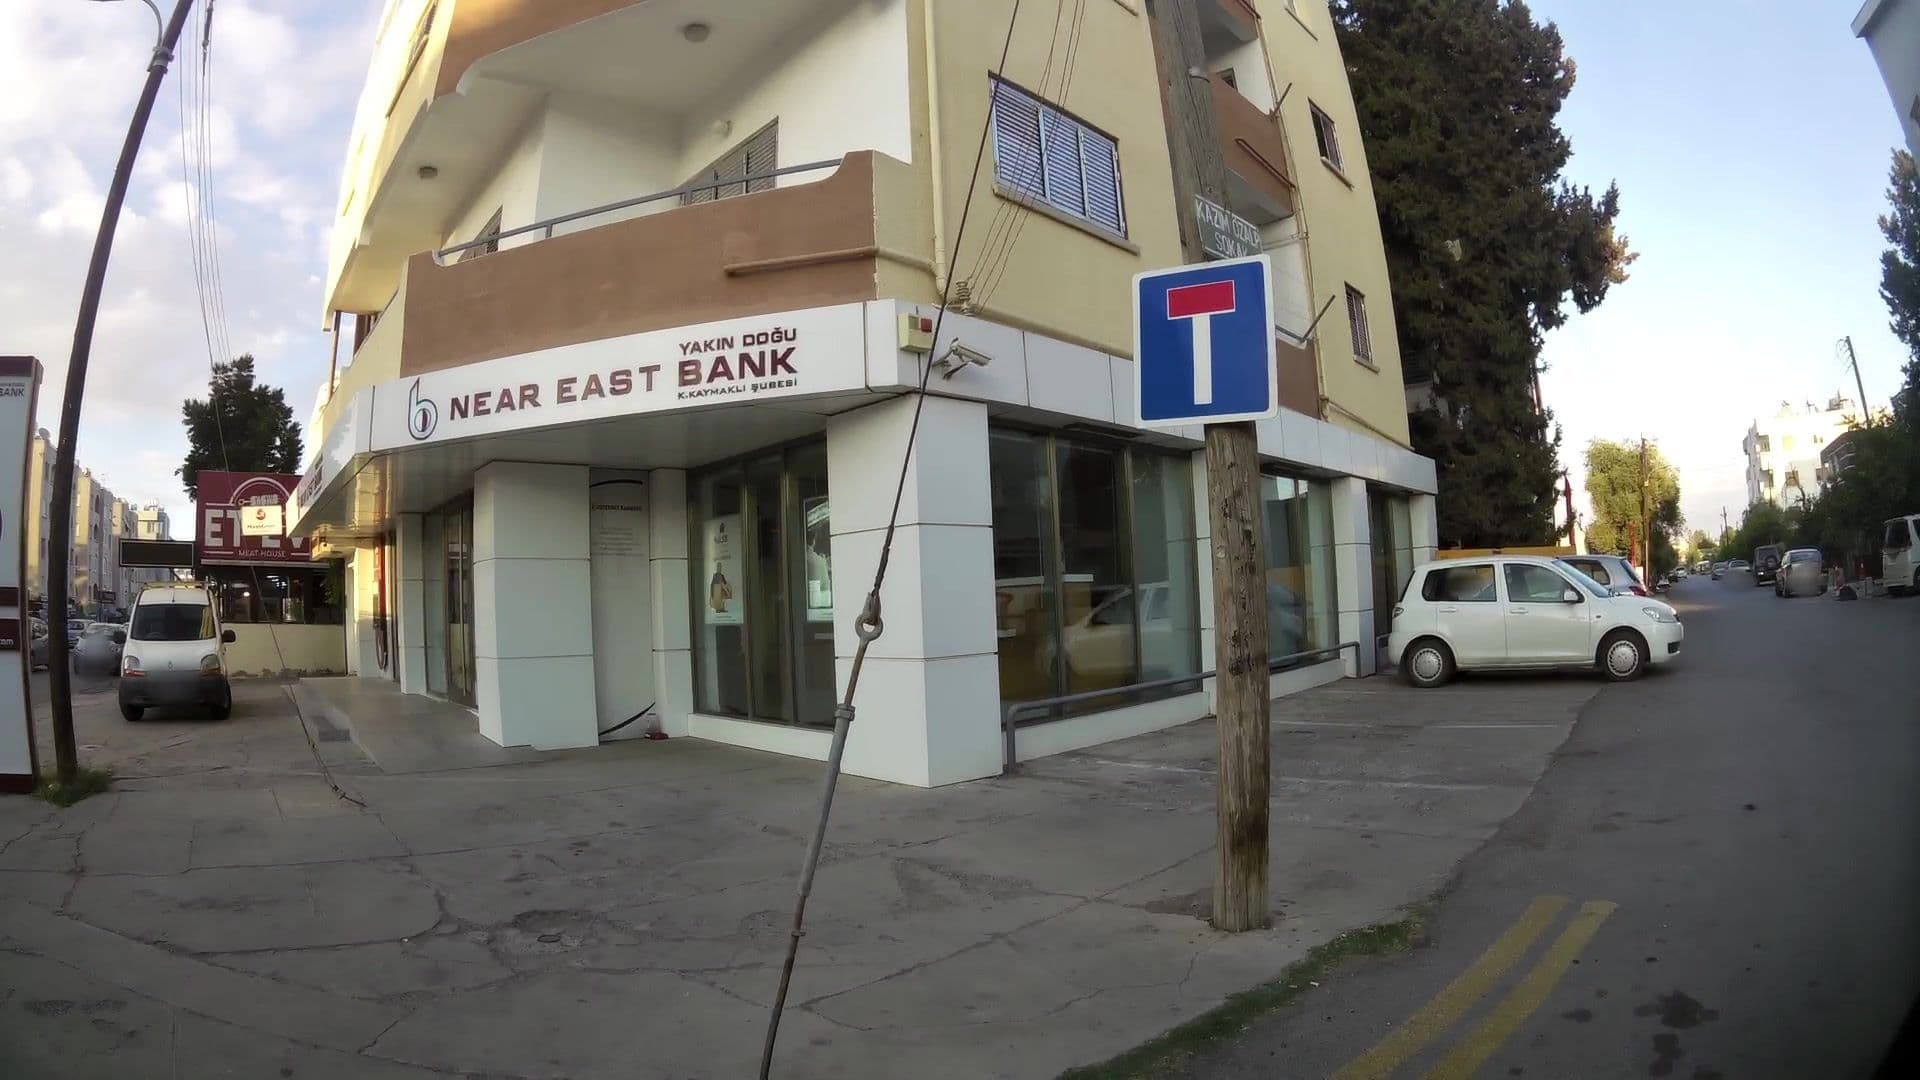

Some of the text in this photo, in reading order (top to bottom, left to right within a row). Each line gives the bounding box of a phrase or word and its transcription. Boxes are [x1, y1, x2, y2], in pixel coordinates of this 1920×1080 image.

[679, 327, 797, 356] YAKIN DOĞU
[450, 346, 798, 421] NEAR EAST BANK
[677, 376, 798, 400] K.KAYMAKLI ŞUBESİ
[238, 549, 288, 558] MEAT HOUSE
